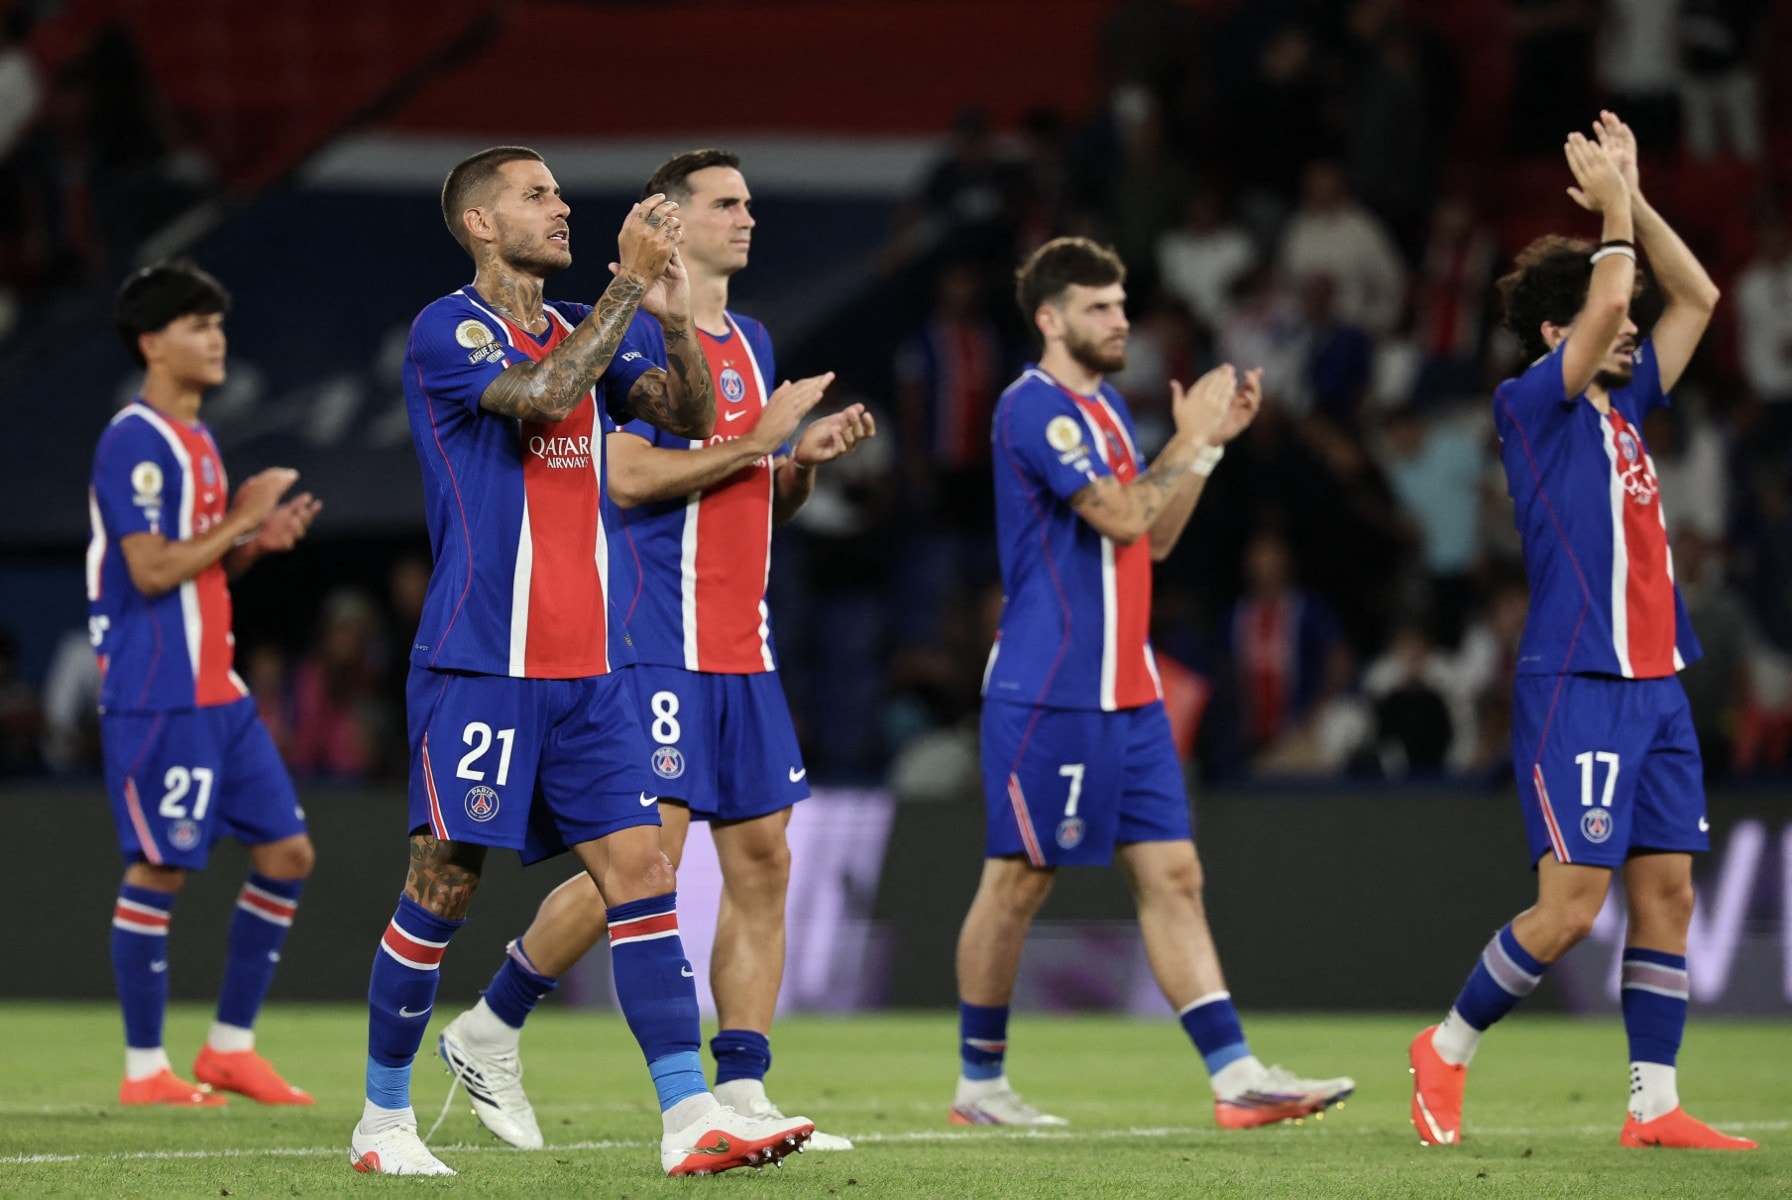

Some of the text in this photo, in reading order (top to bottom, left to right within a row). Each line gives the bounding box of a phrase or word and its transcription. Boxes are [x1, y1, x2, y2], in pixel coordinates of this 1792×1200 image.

[529, 436, 590, 459] QATAR
[651, 691, 681, 744] 8
[456, 721, 515, 785] 21
[1575, 751, 1619, 807] 17
[159, 765, 213, 820] 27
[471, 787, 495, 798] PARIS
[1059, 763, 1085, 816] 7
